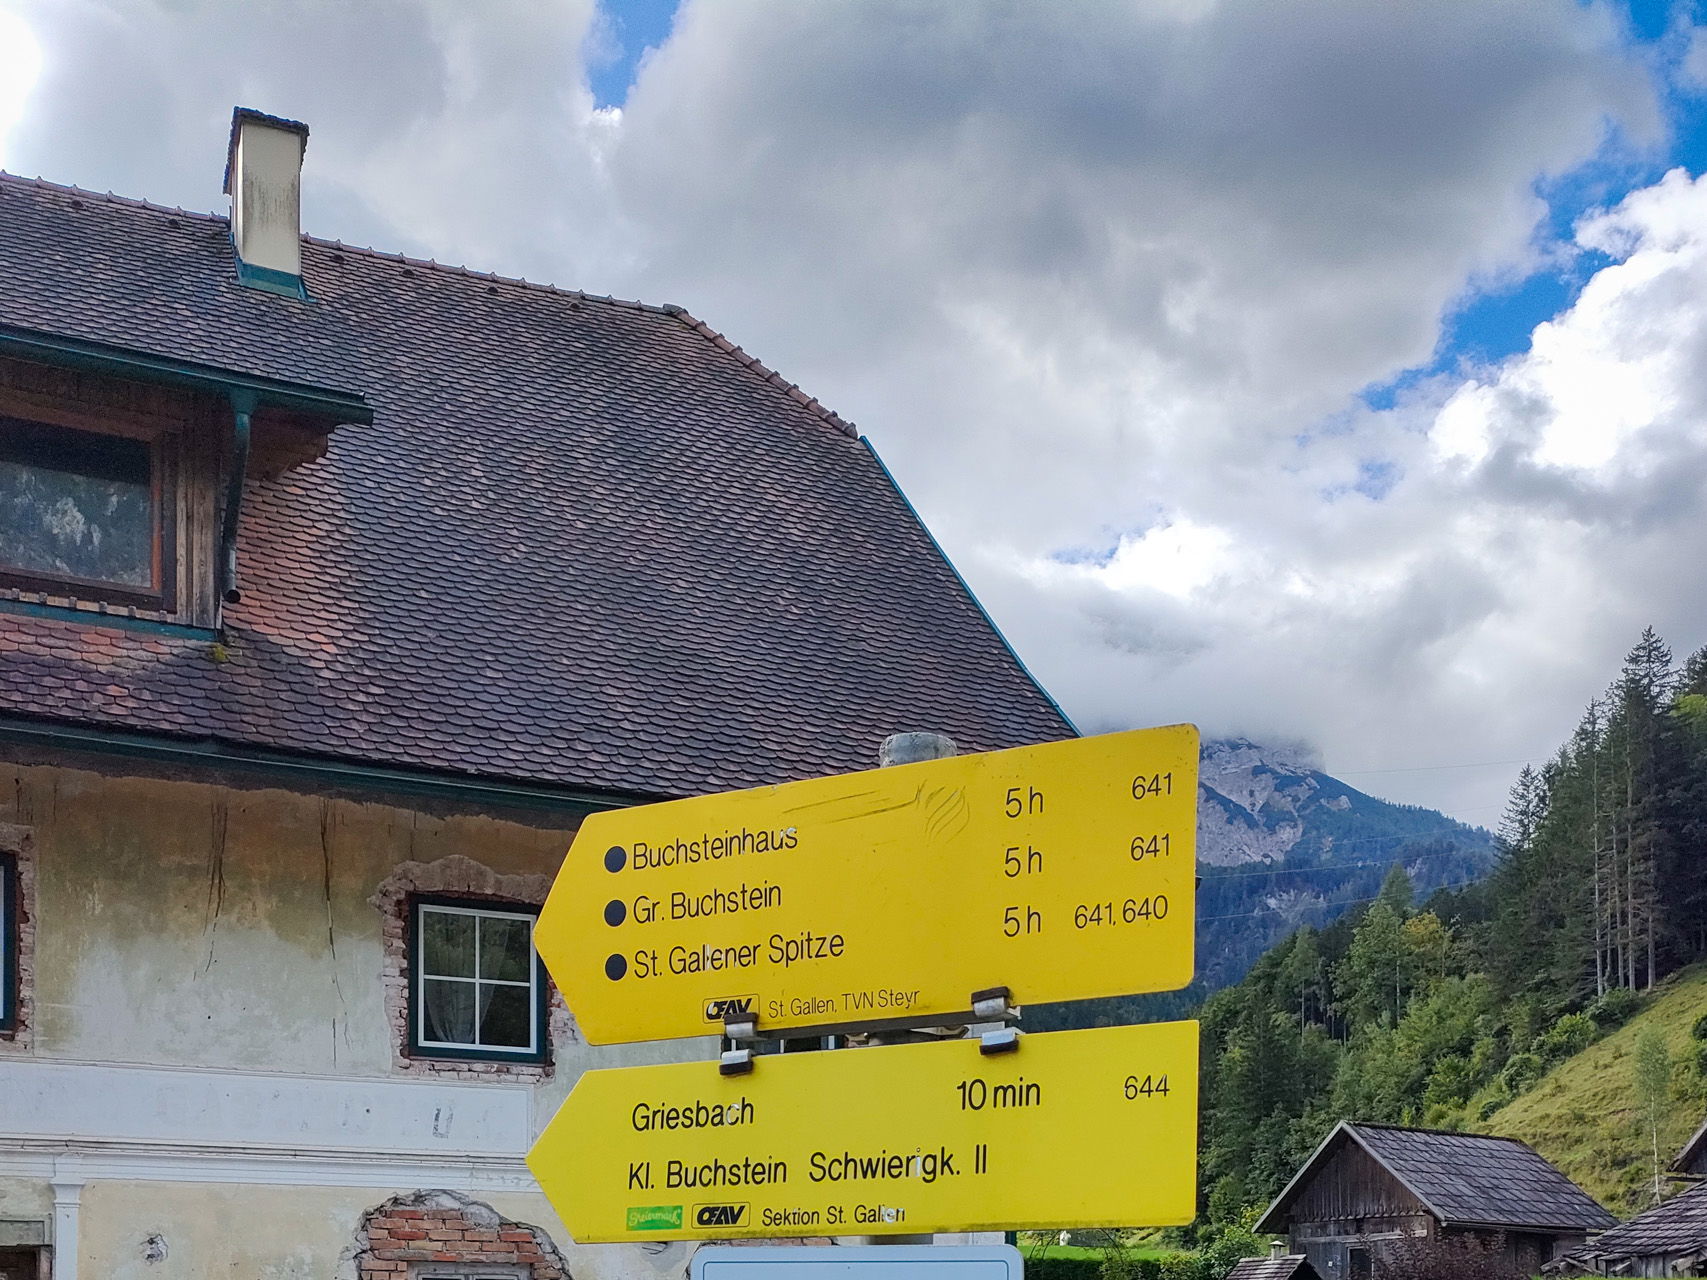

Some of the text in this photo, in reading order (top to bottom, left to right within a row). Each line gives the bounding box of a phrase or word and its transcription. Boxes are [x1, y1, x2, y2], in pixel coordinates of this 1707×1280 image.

[633, 771, 1172, 870] Buchsteinhaus 5 h 641
[633, 833, 1170, 924] Gr. Buchstein 5 h 641
[634, 950, 663, 979] St.
[668, 943, 762, 975] Galener
[768, 931, 845, 968] Spitze
[1003, 906, 1020, 937] 5
[1026, 905, 1041, 934] h
[768, 1000, 787, 1018] St.
[790, 997, 837, 1016] Gallen,
[841, 991, 874, 1010] TVN
[877, 989, 921, 1009] Steyr
[632, 1074, 1170, 1131] Griesbach 10 min 644
[628, 1162, 655, 1190] Kl.
[666, 1155, 787, 1189] Buchstein
[808, 1146, 961, 1183] Schwierigk.
[761, 1207, 820, 1226] Sektion
[826, 1205, 847, 1225] St.
